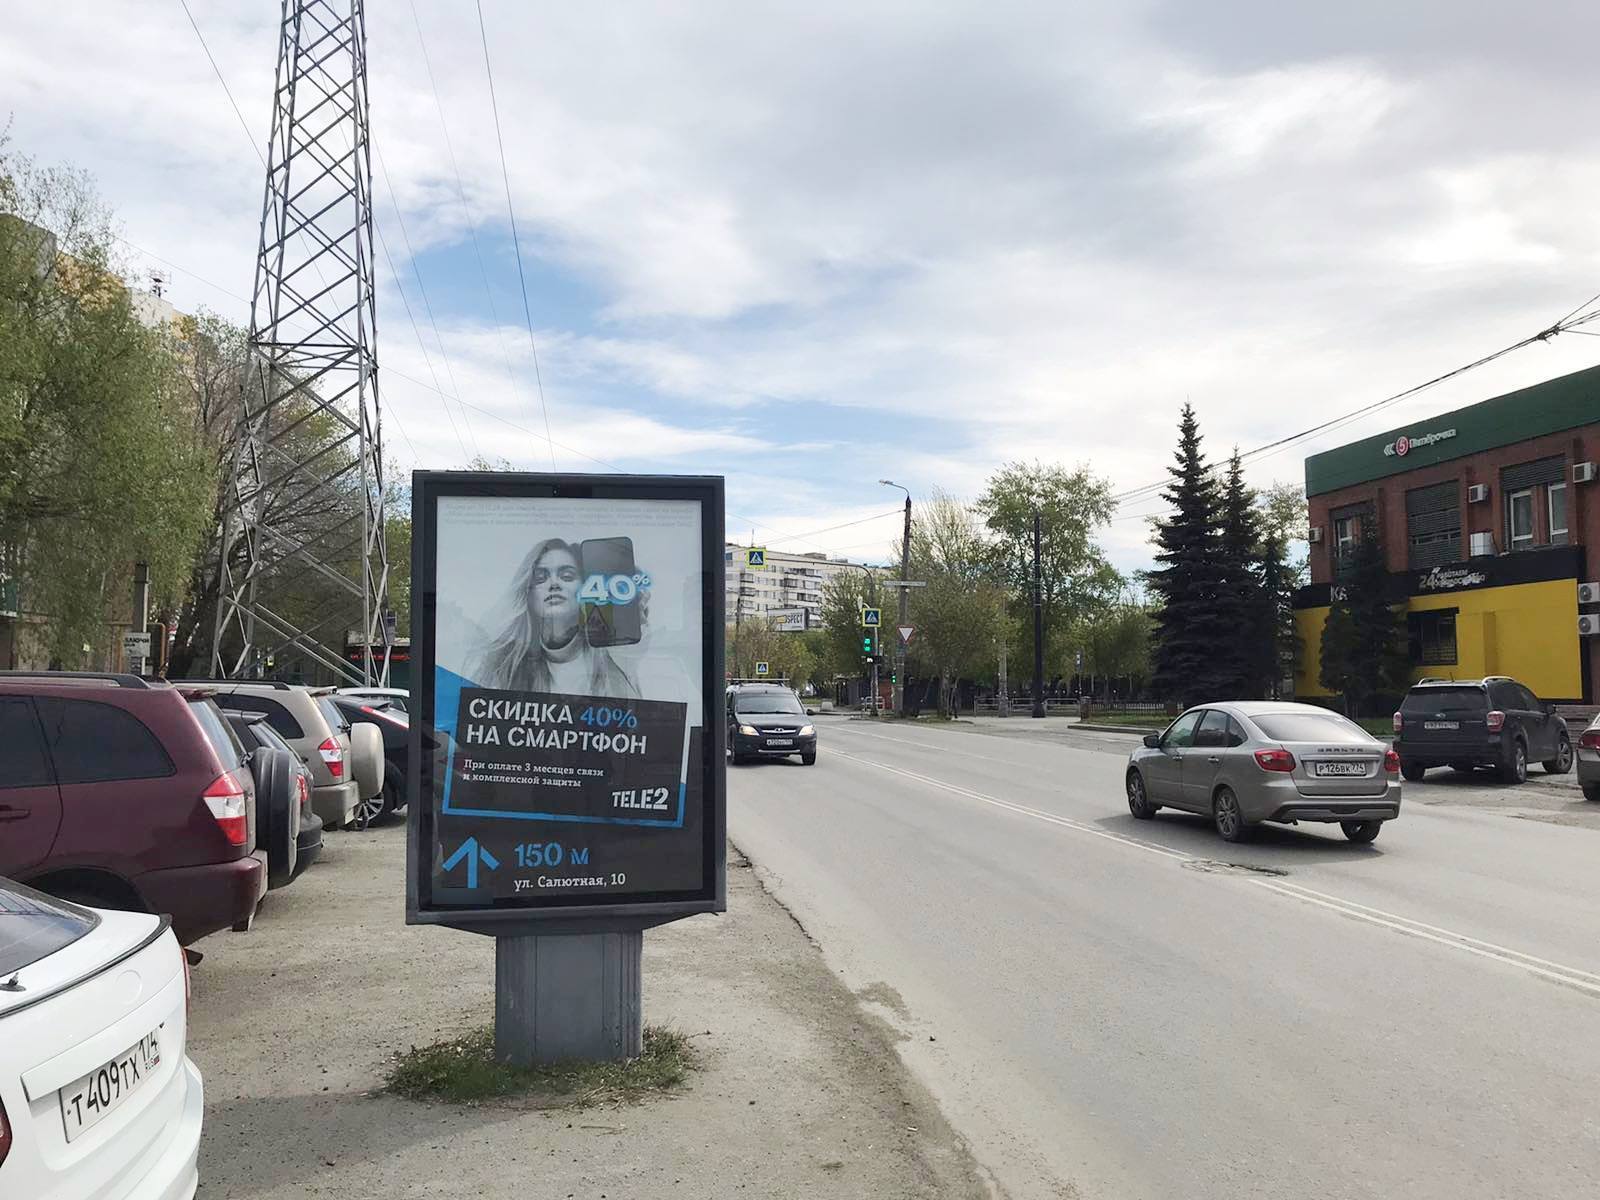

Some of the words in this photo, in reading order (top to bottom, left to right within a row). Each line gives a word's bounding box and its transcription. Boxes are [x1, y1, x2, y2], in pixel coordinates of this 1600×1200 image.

[579, 573, 651, 603] 40%
[468, 697, 574, 727] СКИДКА
[580, 706, 638, 729] 40%
[466, 724, 501, 746] НА
[507, 726, 647, 754] СМАРТФОН
[464, 759, 485, 772] При
[487, 762, 522, 773] оплате
[524, 763, 531, 772] 3
[533, 765, 574, 777] месяцев
[577, 768, 604, 777] связи
[463, 773, 470, 781] и
[472, 773, 540, 785] комплексной
[542, 778, 581, 788] защиты
[612, 787, 669, 810] TELE2
[515, 842, 563, 867] 150
[514, 878, 533, 891] ул.
[538, 875, 607, 888] Салютная,
[611, 873, 626, 885] 10
